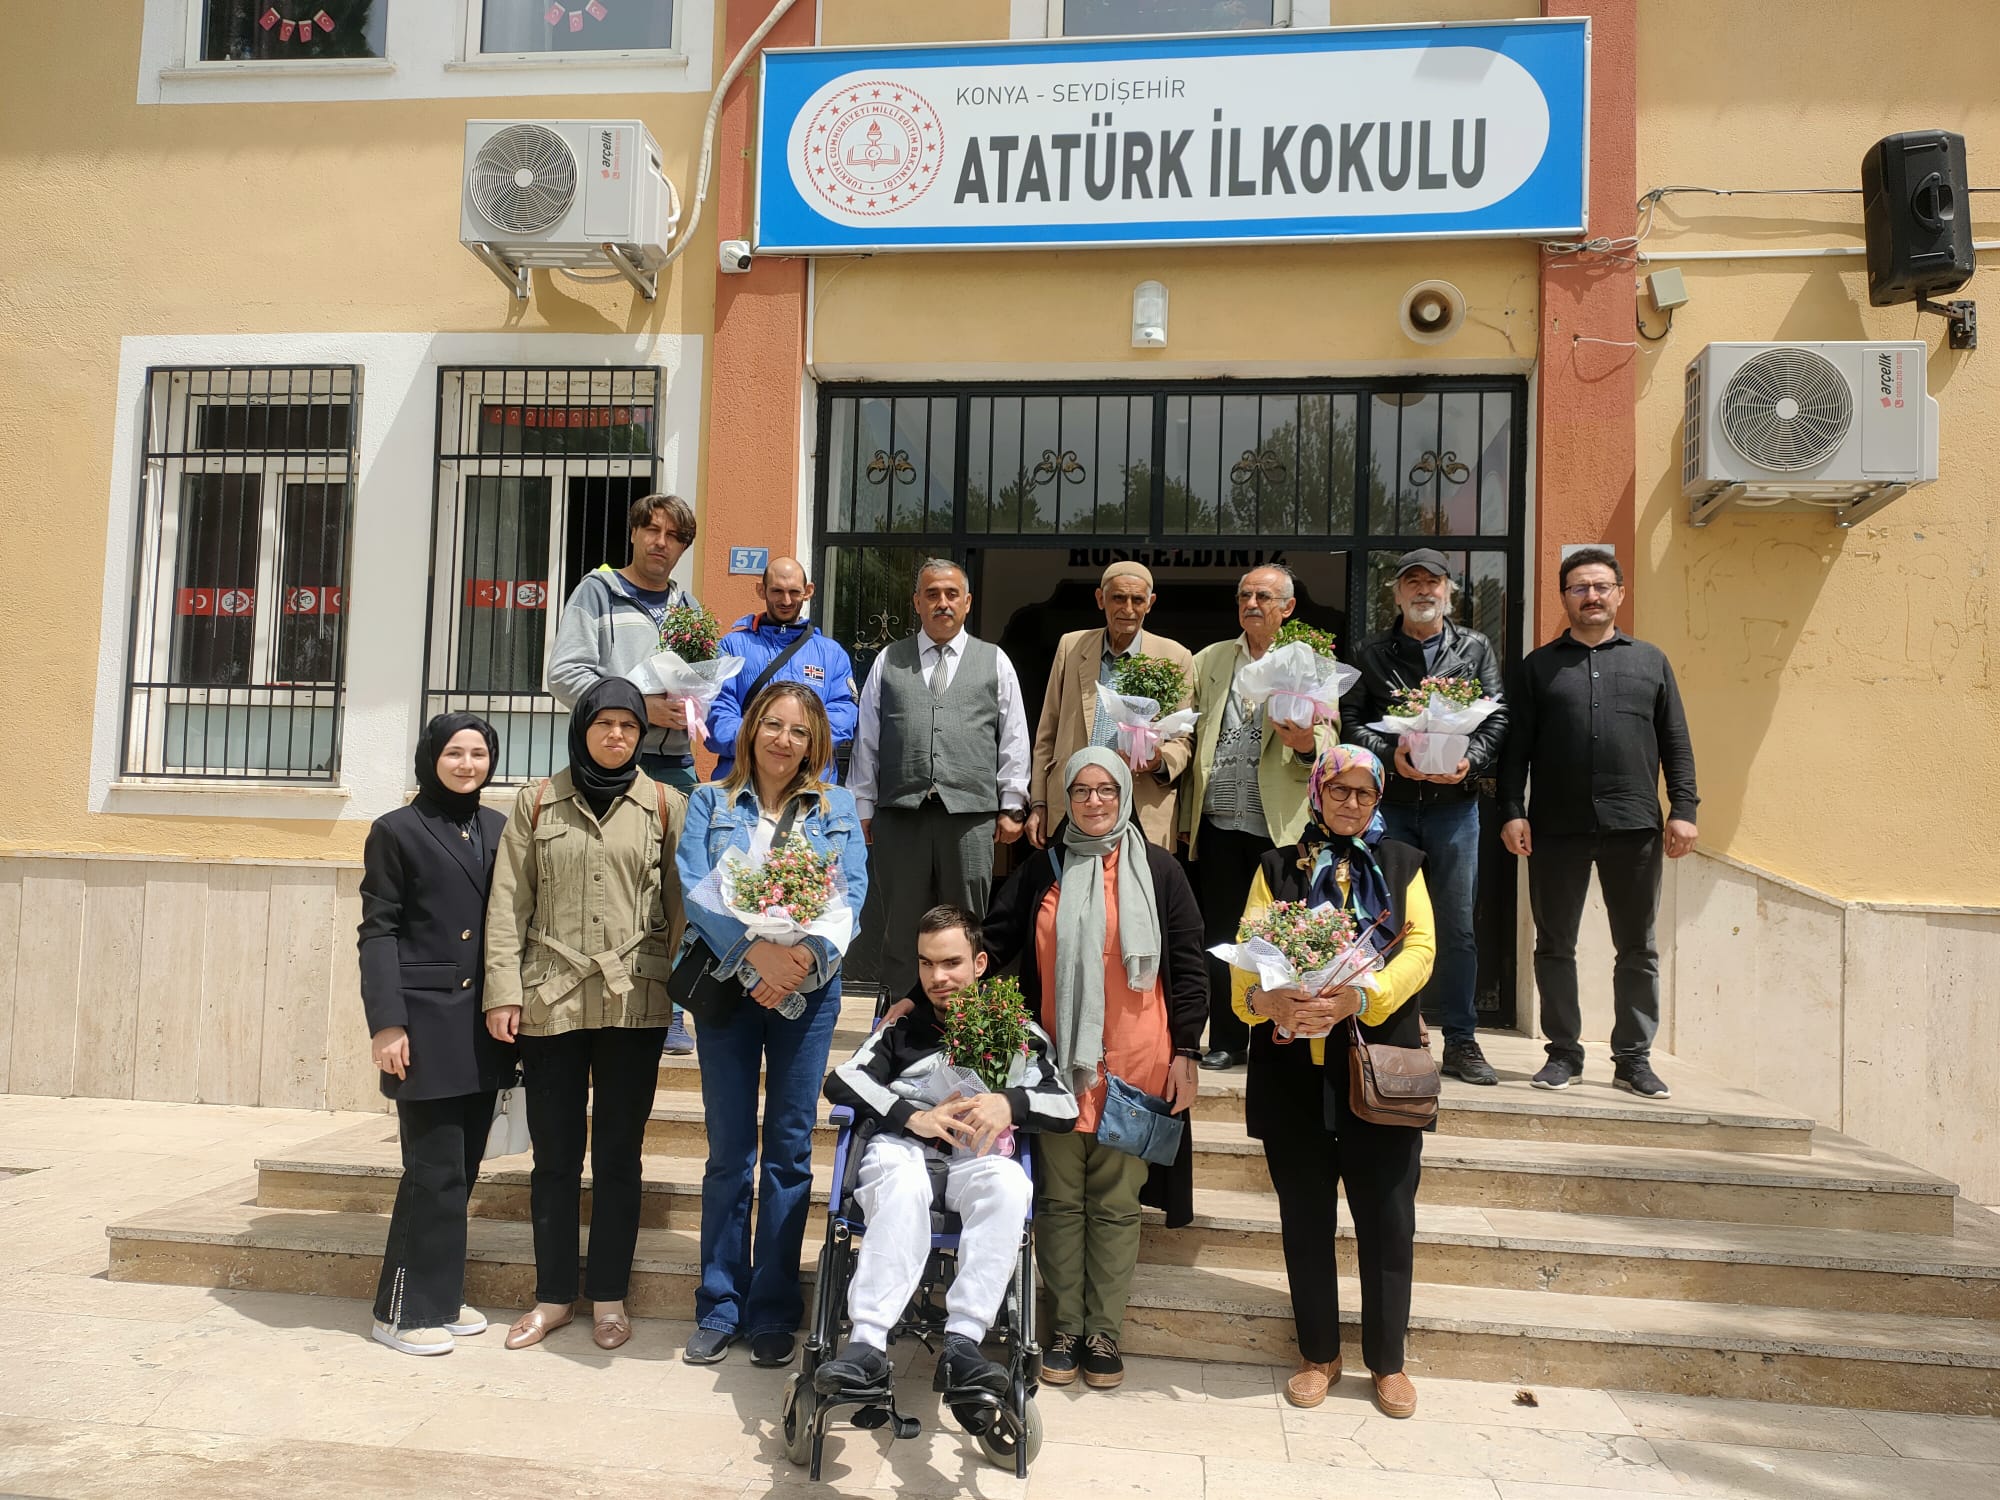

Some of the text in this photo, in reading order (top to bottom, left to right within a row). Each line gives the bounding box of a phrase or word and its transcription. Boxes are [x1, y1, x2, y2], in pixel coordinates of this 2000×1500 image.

[956, 85, 1030, 106] KONYA
[1052, 76, 1185, 106] SEYDİŞEHİR
[601, 130, 614, 168] arçelik
[883, 146, 919, 190] BAKANLIĞI
[953, 107, 1487, 204] ATATÜRK İLKOKULU
[1879, 352, 1893, 395] arçelik
[735, 550, 763, 569] 57
